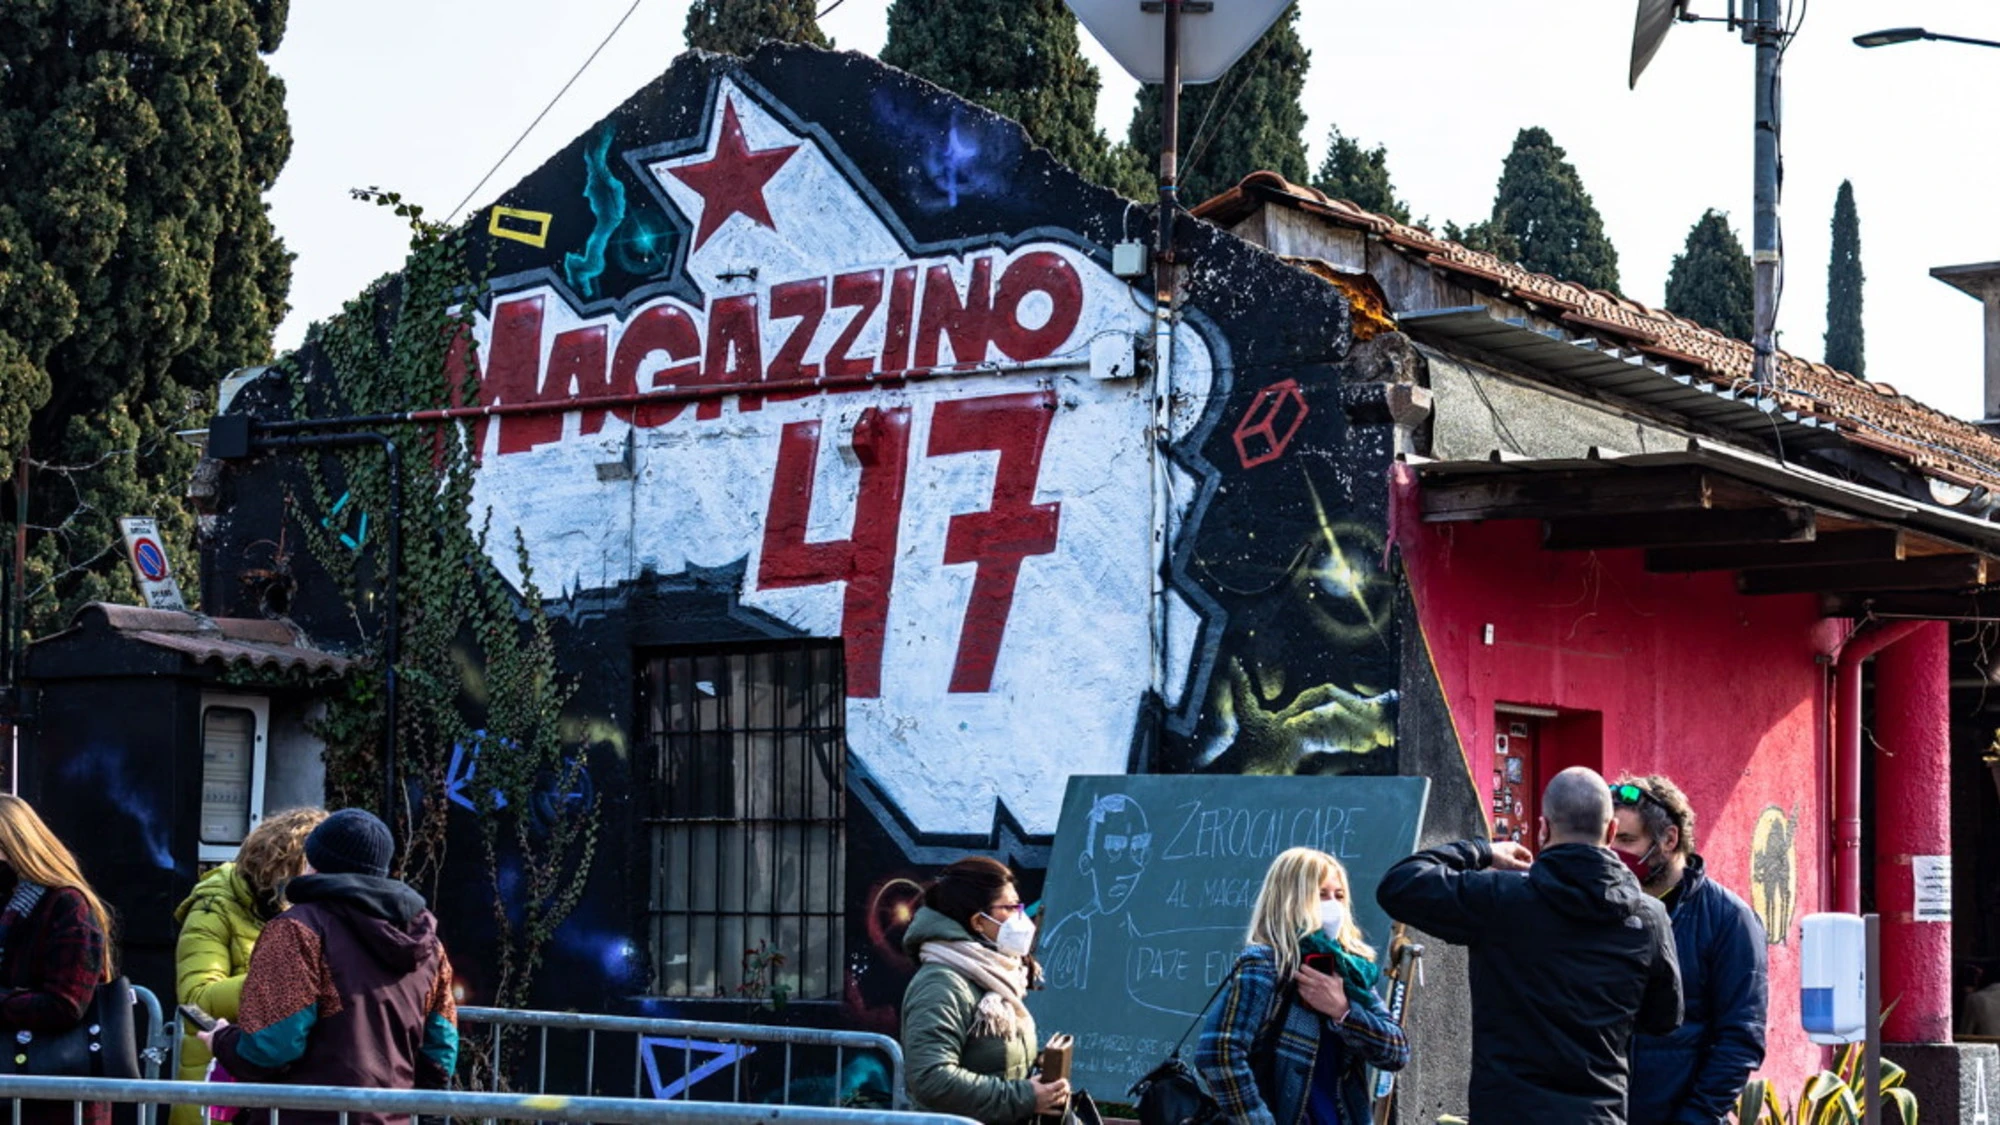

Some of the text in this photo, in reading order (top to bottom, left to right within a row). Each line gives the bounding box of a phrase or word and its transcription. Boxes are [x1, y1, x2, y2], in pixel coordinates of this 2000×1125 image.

[433, 251, 1083, 467] MAGAZZINO
[756, 389, 1060, 699] 47
[1161, 800, 1367, 860] ZEROCALCARE
[1165, 878, 1264, 909] AL MAGAZ
